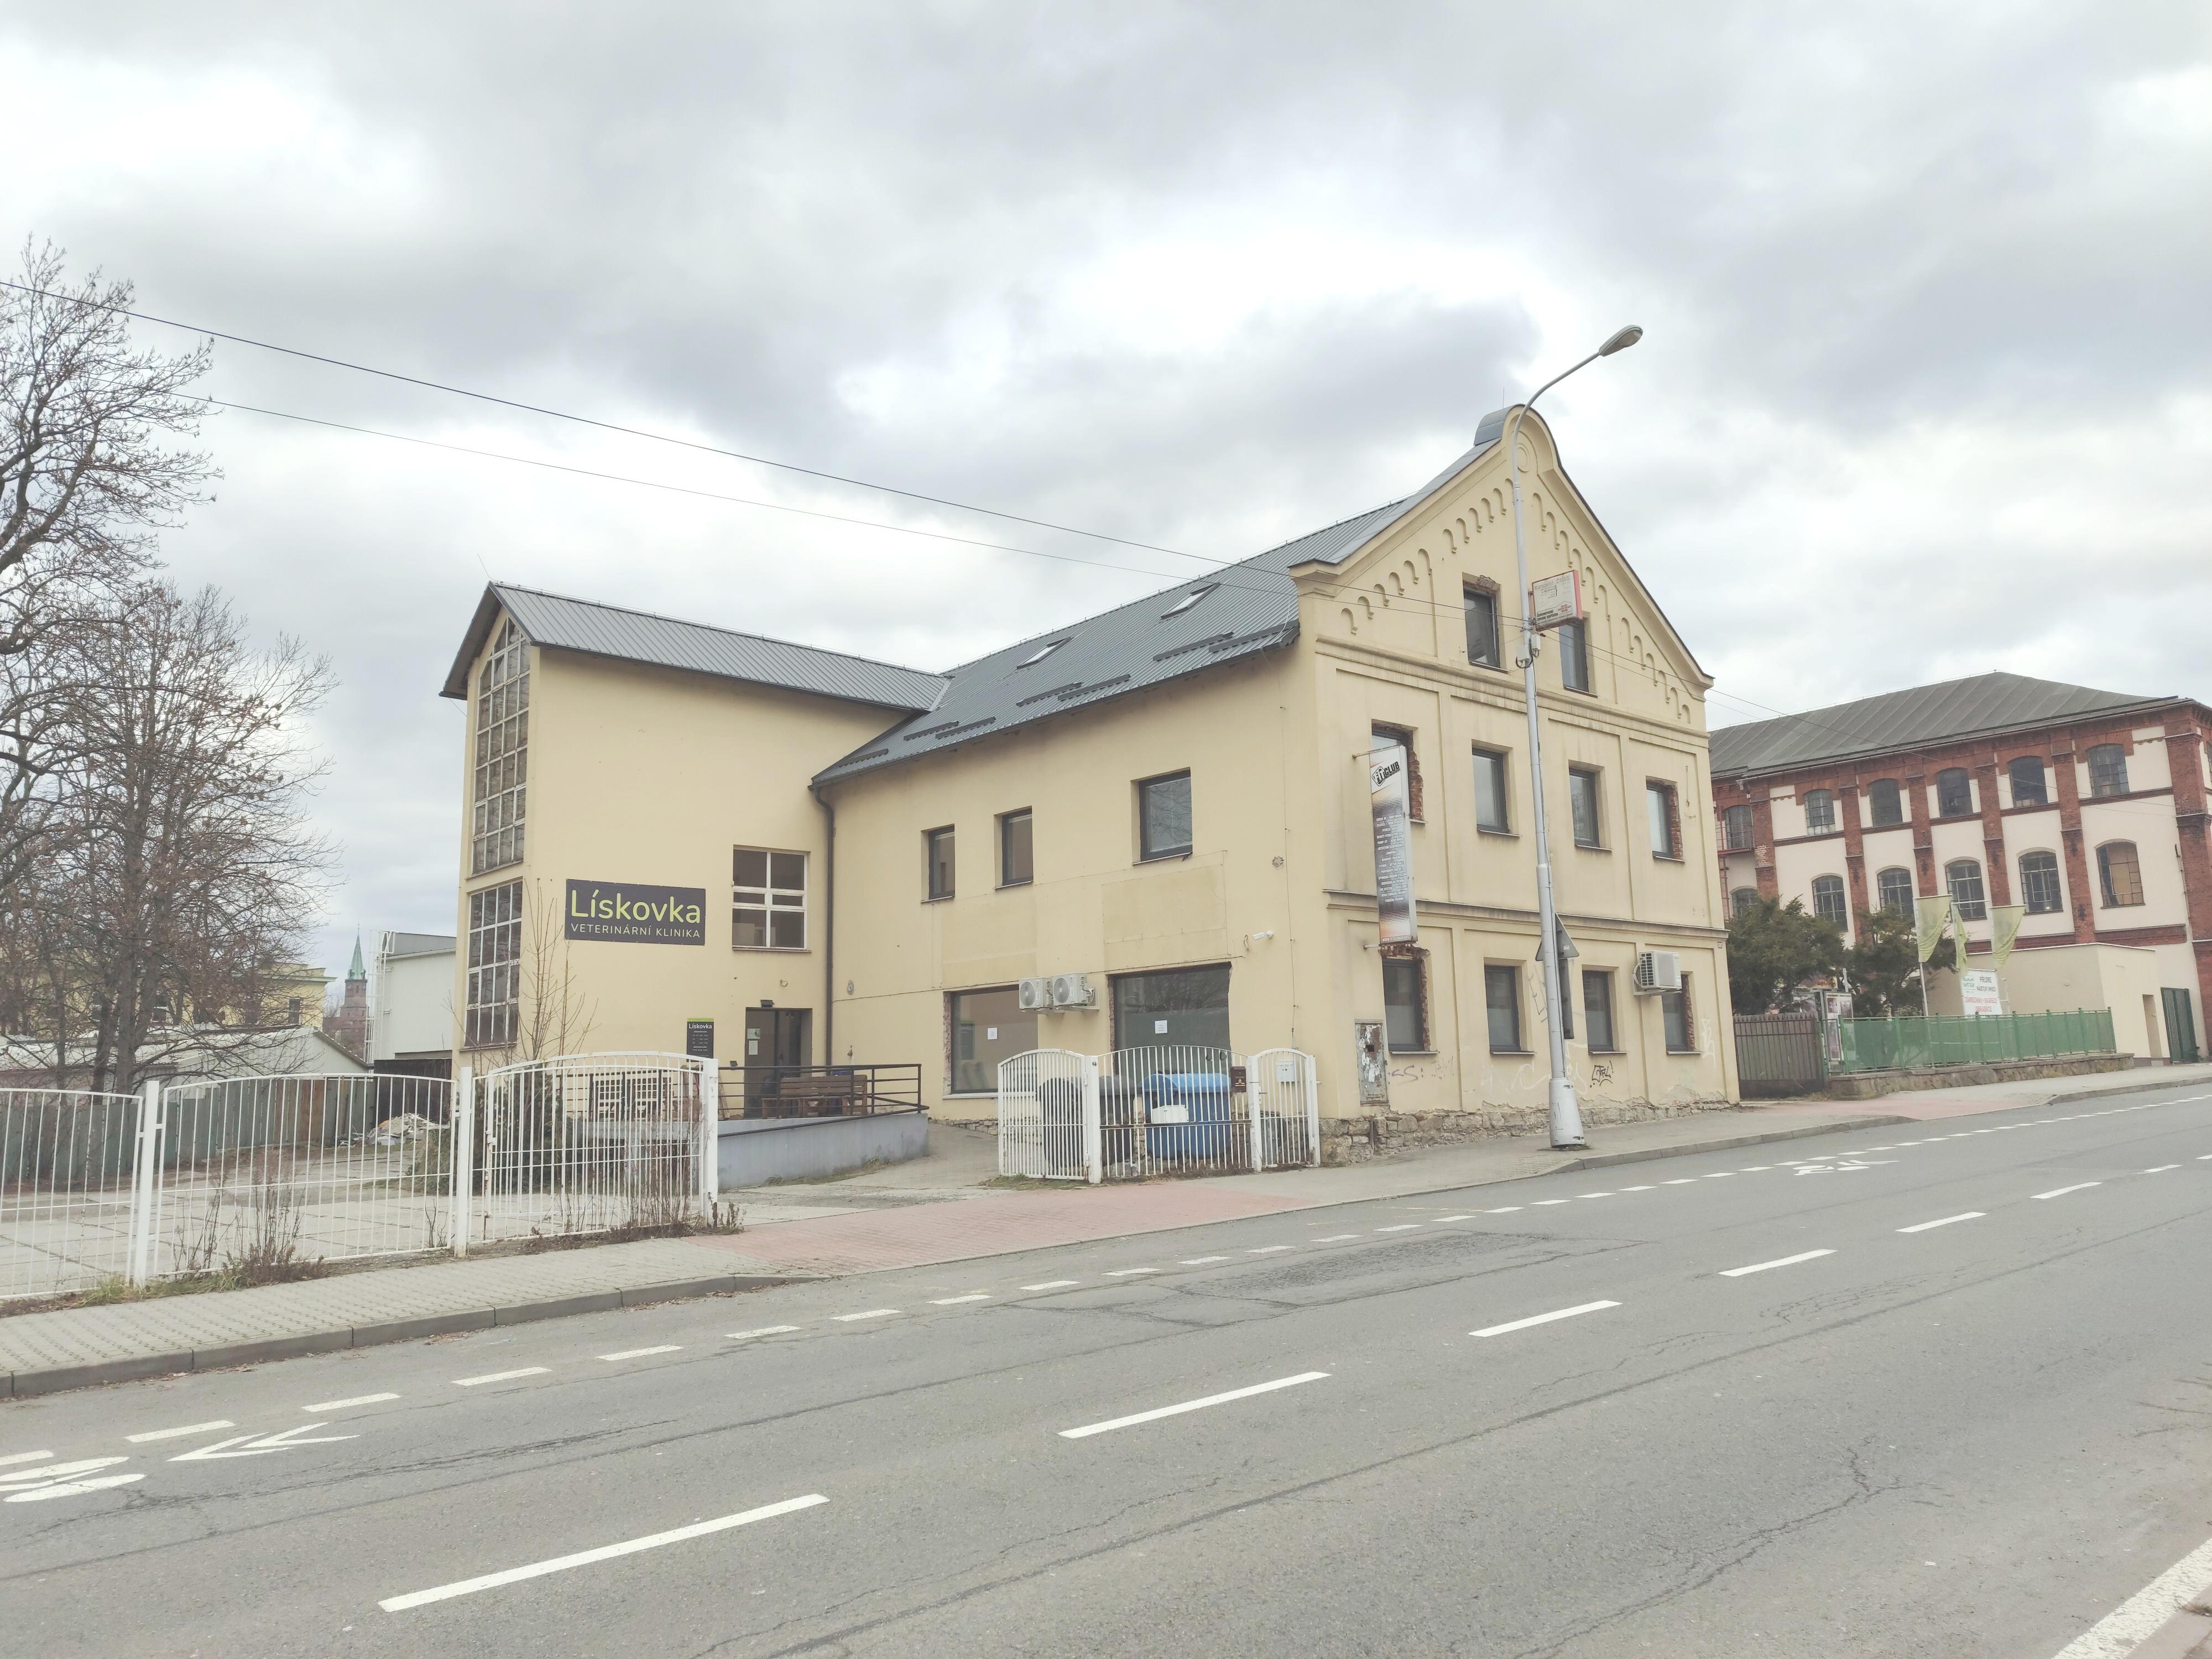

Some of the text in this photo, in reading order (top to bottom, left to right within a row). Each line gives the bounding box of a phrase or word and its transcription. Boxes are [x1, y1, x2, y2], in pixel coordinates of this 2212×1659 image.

[571, 889, 700, 924] Lískovka
[571, 923, 700, 938] VETERINÁRNÍ KLINIKA
